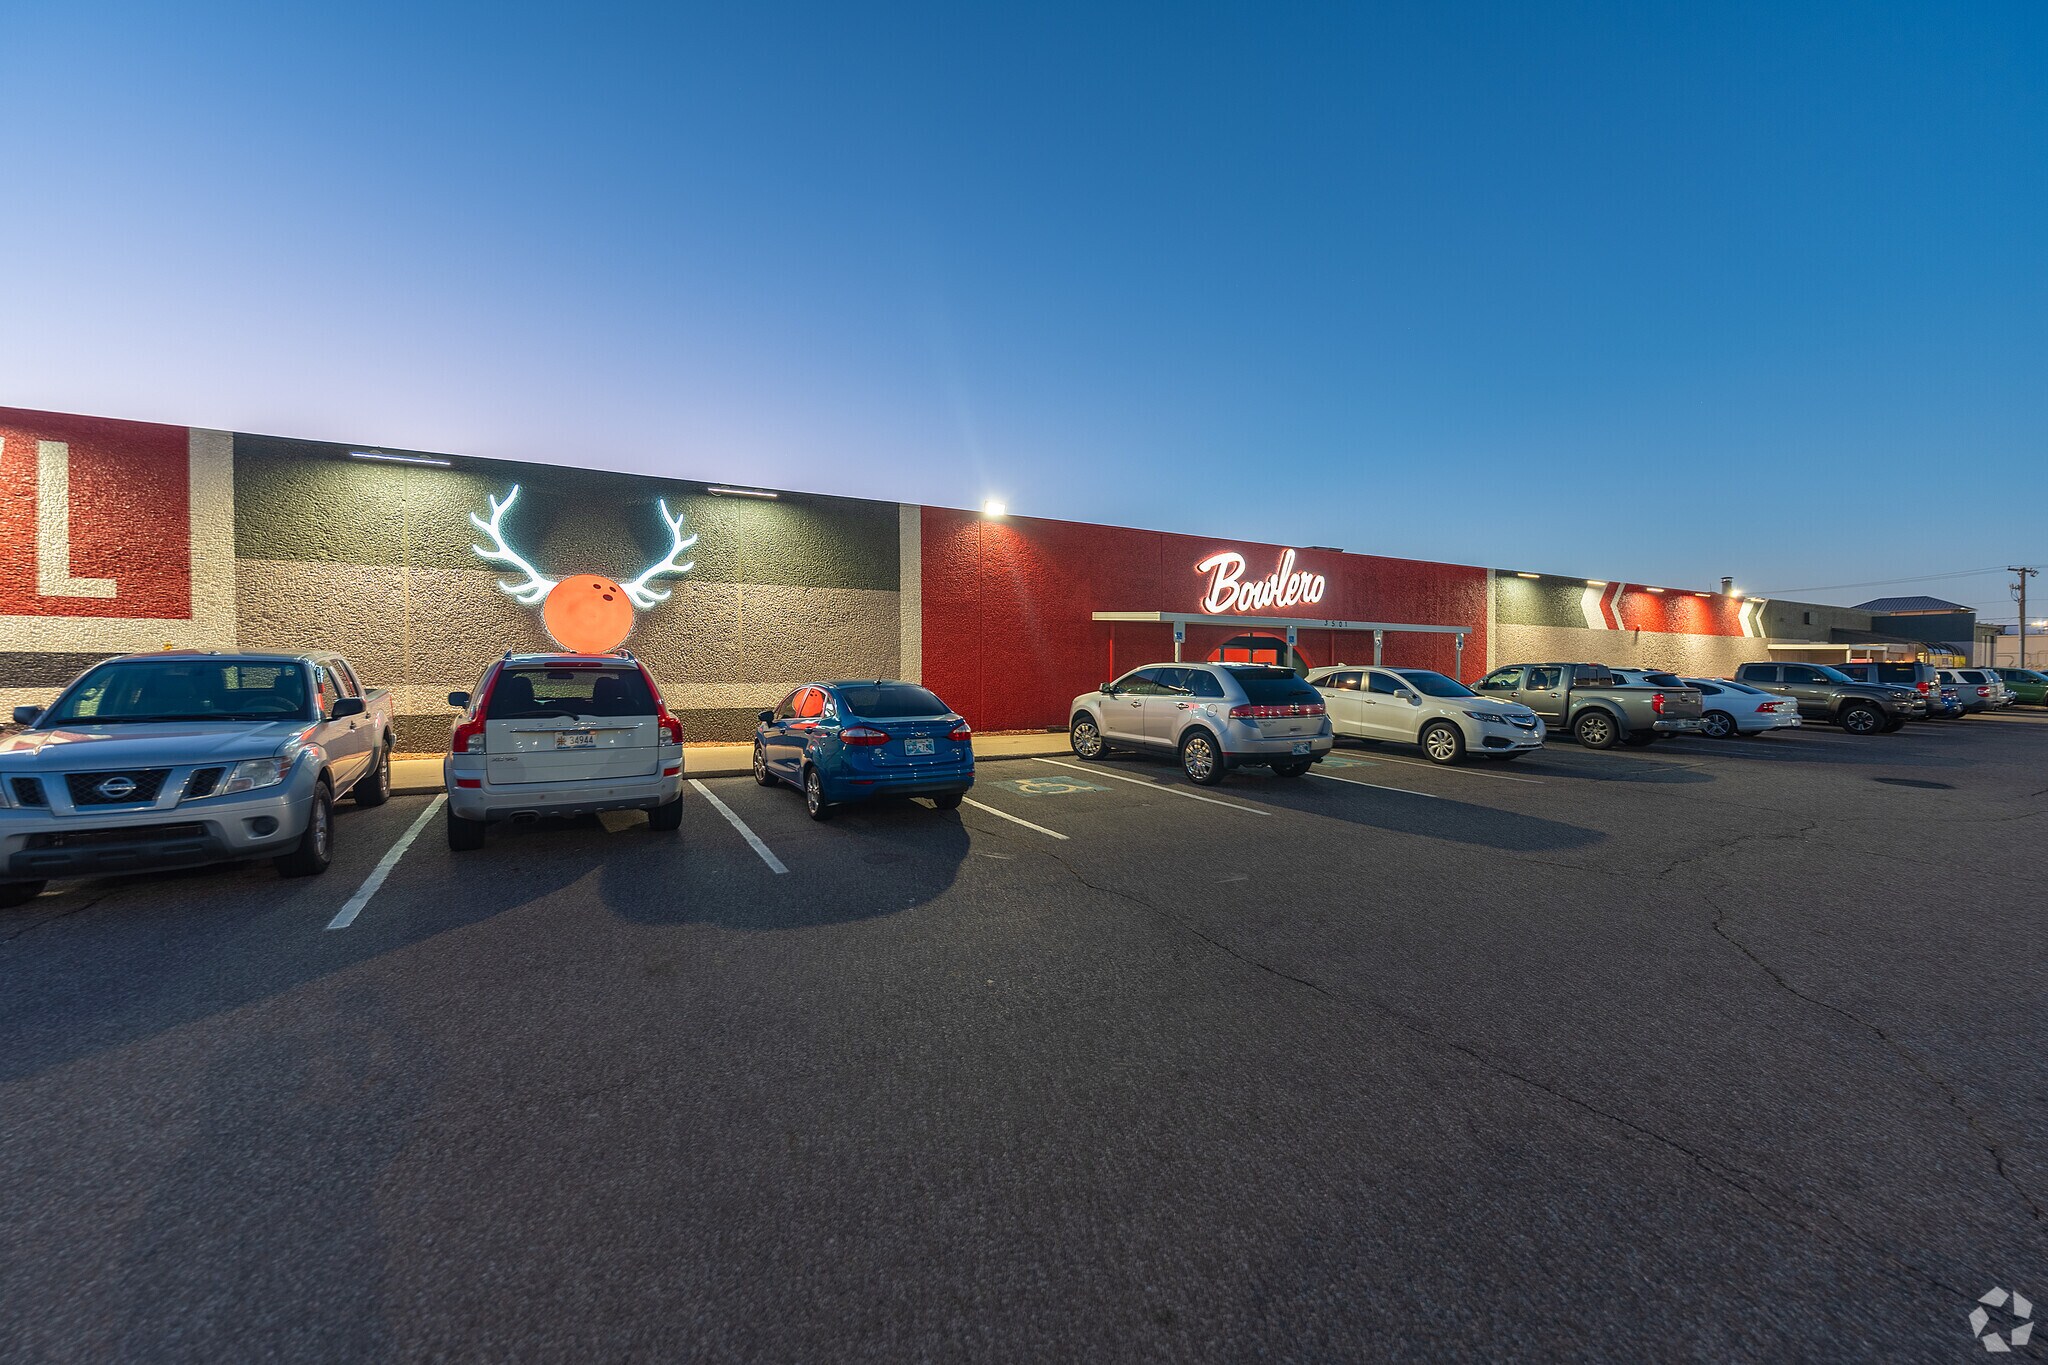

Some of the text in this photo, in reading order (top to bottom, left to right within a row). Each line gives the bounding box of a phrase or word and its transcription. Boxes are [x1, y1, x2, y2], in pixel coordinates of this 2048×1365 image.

[0, 437, 117, 598] L
[1197, 548, 1326, 613] Bowlero
[570, 735, 594, 744] 34944
